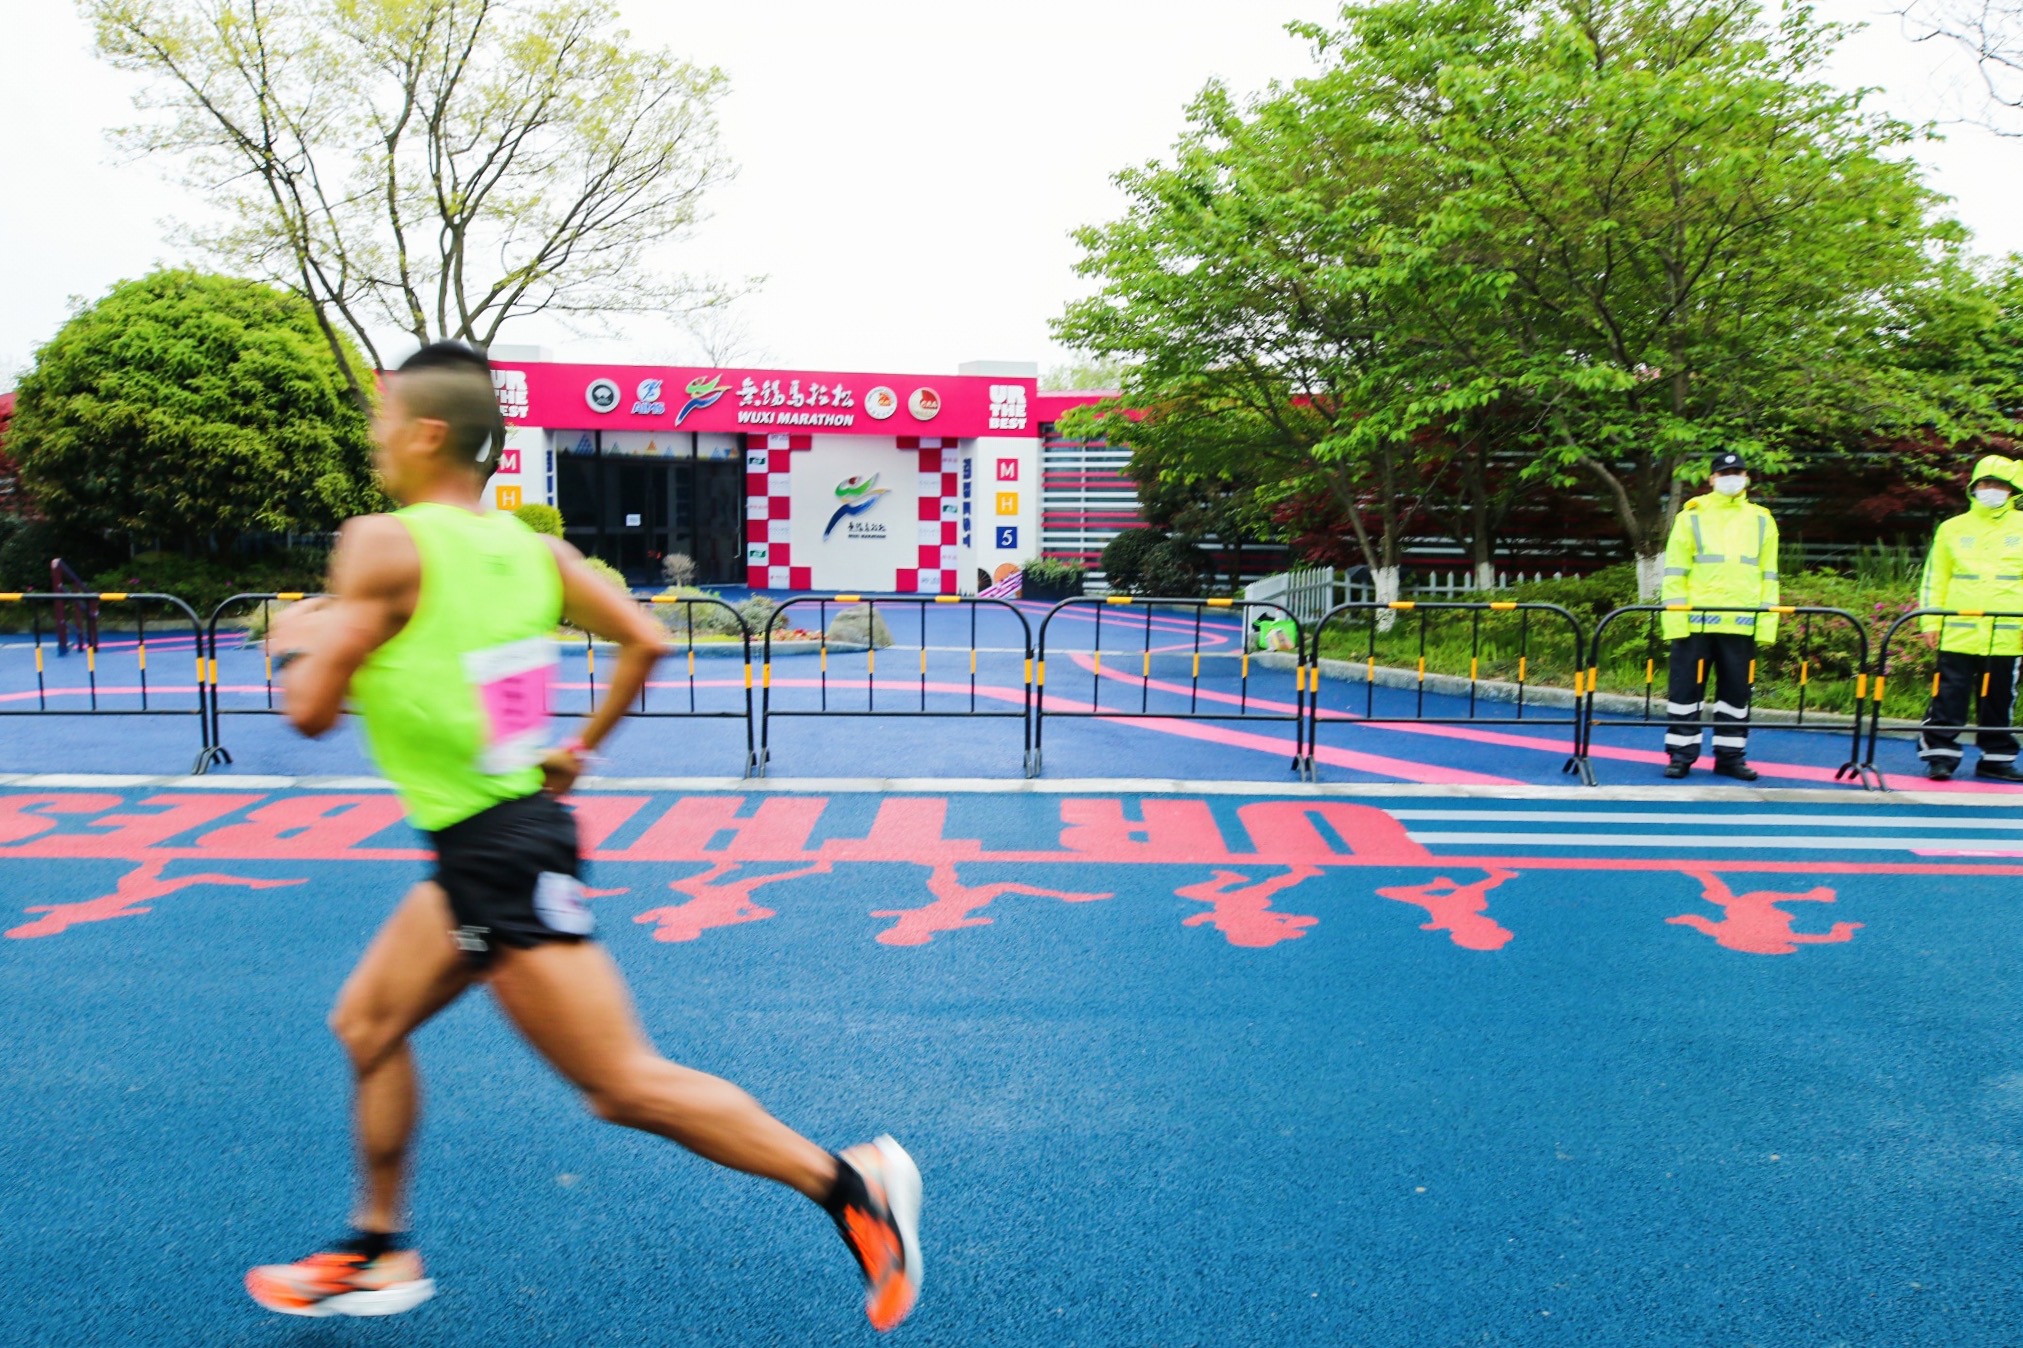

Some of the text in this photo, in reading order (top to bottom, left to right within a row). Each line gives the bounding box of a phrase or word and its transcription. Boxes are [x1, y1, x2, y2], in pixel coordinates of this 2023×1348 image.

[490, 369, 528, 390] UR
[989, 385, 1026, 404] UR
[499, 405, 530, 419] EST
[738, 411, 855, 427] WUXI MARATHON
[989, 404, 1027, 418] THE
[989, 417, 1027, 430] BEST
[500, 453, 517, 471] M
[1000, 462, 1015, 478] M
[502, 490, 516, 507] H
[1001, 496, 1013, 511] H
[1001, 530, 1013, 546] 5
[0, 793, 405, 848] BES
[1060, 799, 1434, 856] UR
